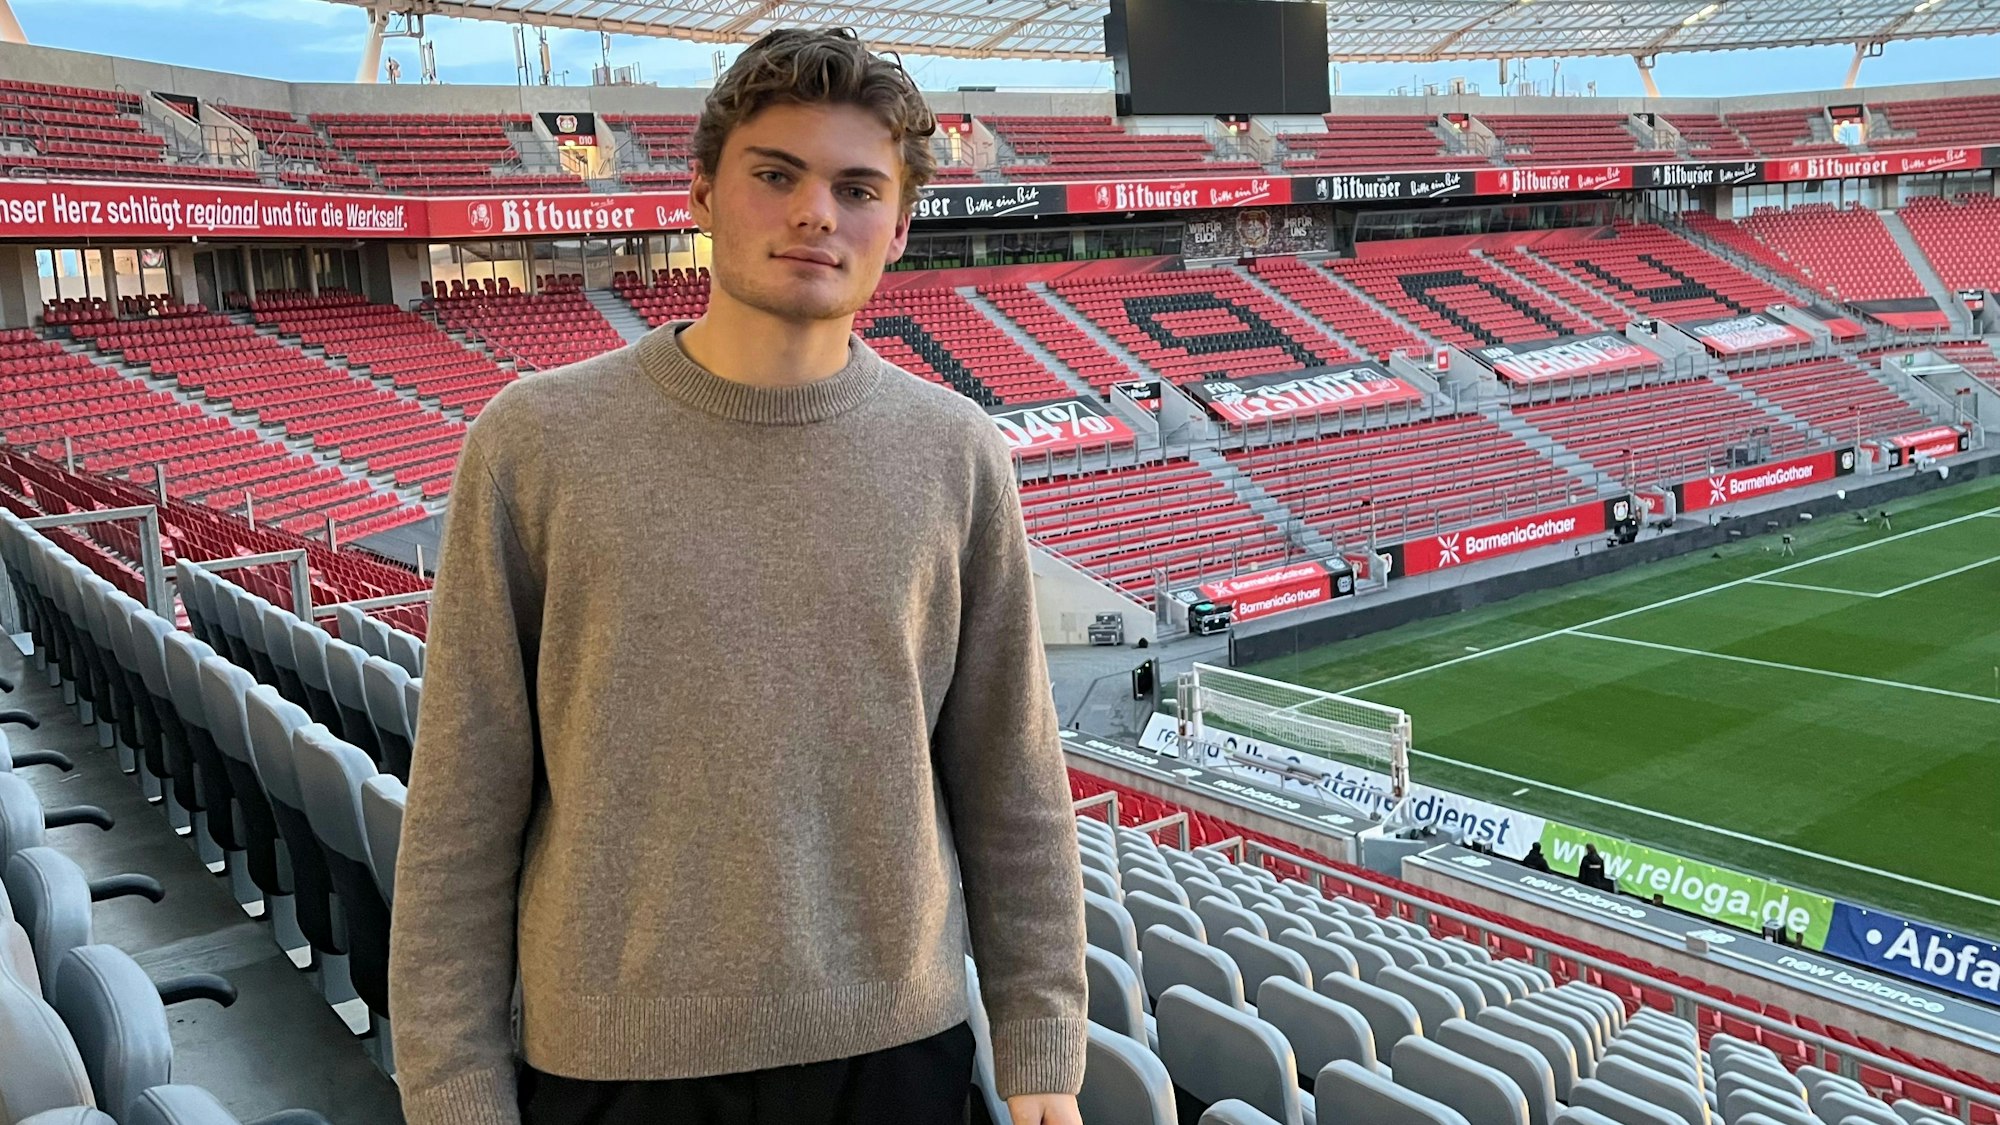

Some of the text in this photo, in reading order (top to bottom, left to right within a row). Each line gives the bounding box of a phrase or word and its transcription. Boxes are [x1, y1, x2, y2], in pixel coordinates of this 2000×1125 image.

[1512, 170, 1570, 192] Bitburger
[1663, 165, 1714, 186] Bitburger
[1807, 158, 1889, 178] Bitburger
[911, 197, 951, 217] ger
[965, 196, 994, 215] Bitte
[1016, 186, 1040, 201] Bit
[1115, 183, 1199, 210] Bitburger
[1251, 179, 1270, 195] Bit
[1332, 175, 1401, 200] Bitburger
[52, 192, 103, 224] Herz
[106, 195, 182, 231] schlägt
[186, 197, 259, 231] regional
[262, 201, 292, 227] und
[295, 202, 317, 228] für
[321, 206, 343, 228] die
[346, 203, 408, 230] Werkself.
[501, 199, 635, 233] Bitburger
[1195, 232, 1217, 244] EUCH
[1290, 226, 1307, 237] UNS
[1729, 464, 1814, 495] BarmeniaGothaer
[1465, 517, 1576, 555] BarmeniaGothaer
[1239, 586, 1322, 616] BarmeniaGothaer
[1519, 875, 1565, 892] new
[1560, 886, 1647, 919] balance
[1883, 928, 2000, 991] Abfa
[1777, 955, 1835, 978] new
[1831, 970, 1946, 1014] balance
